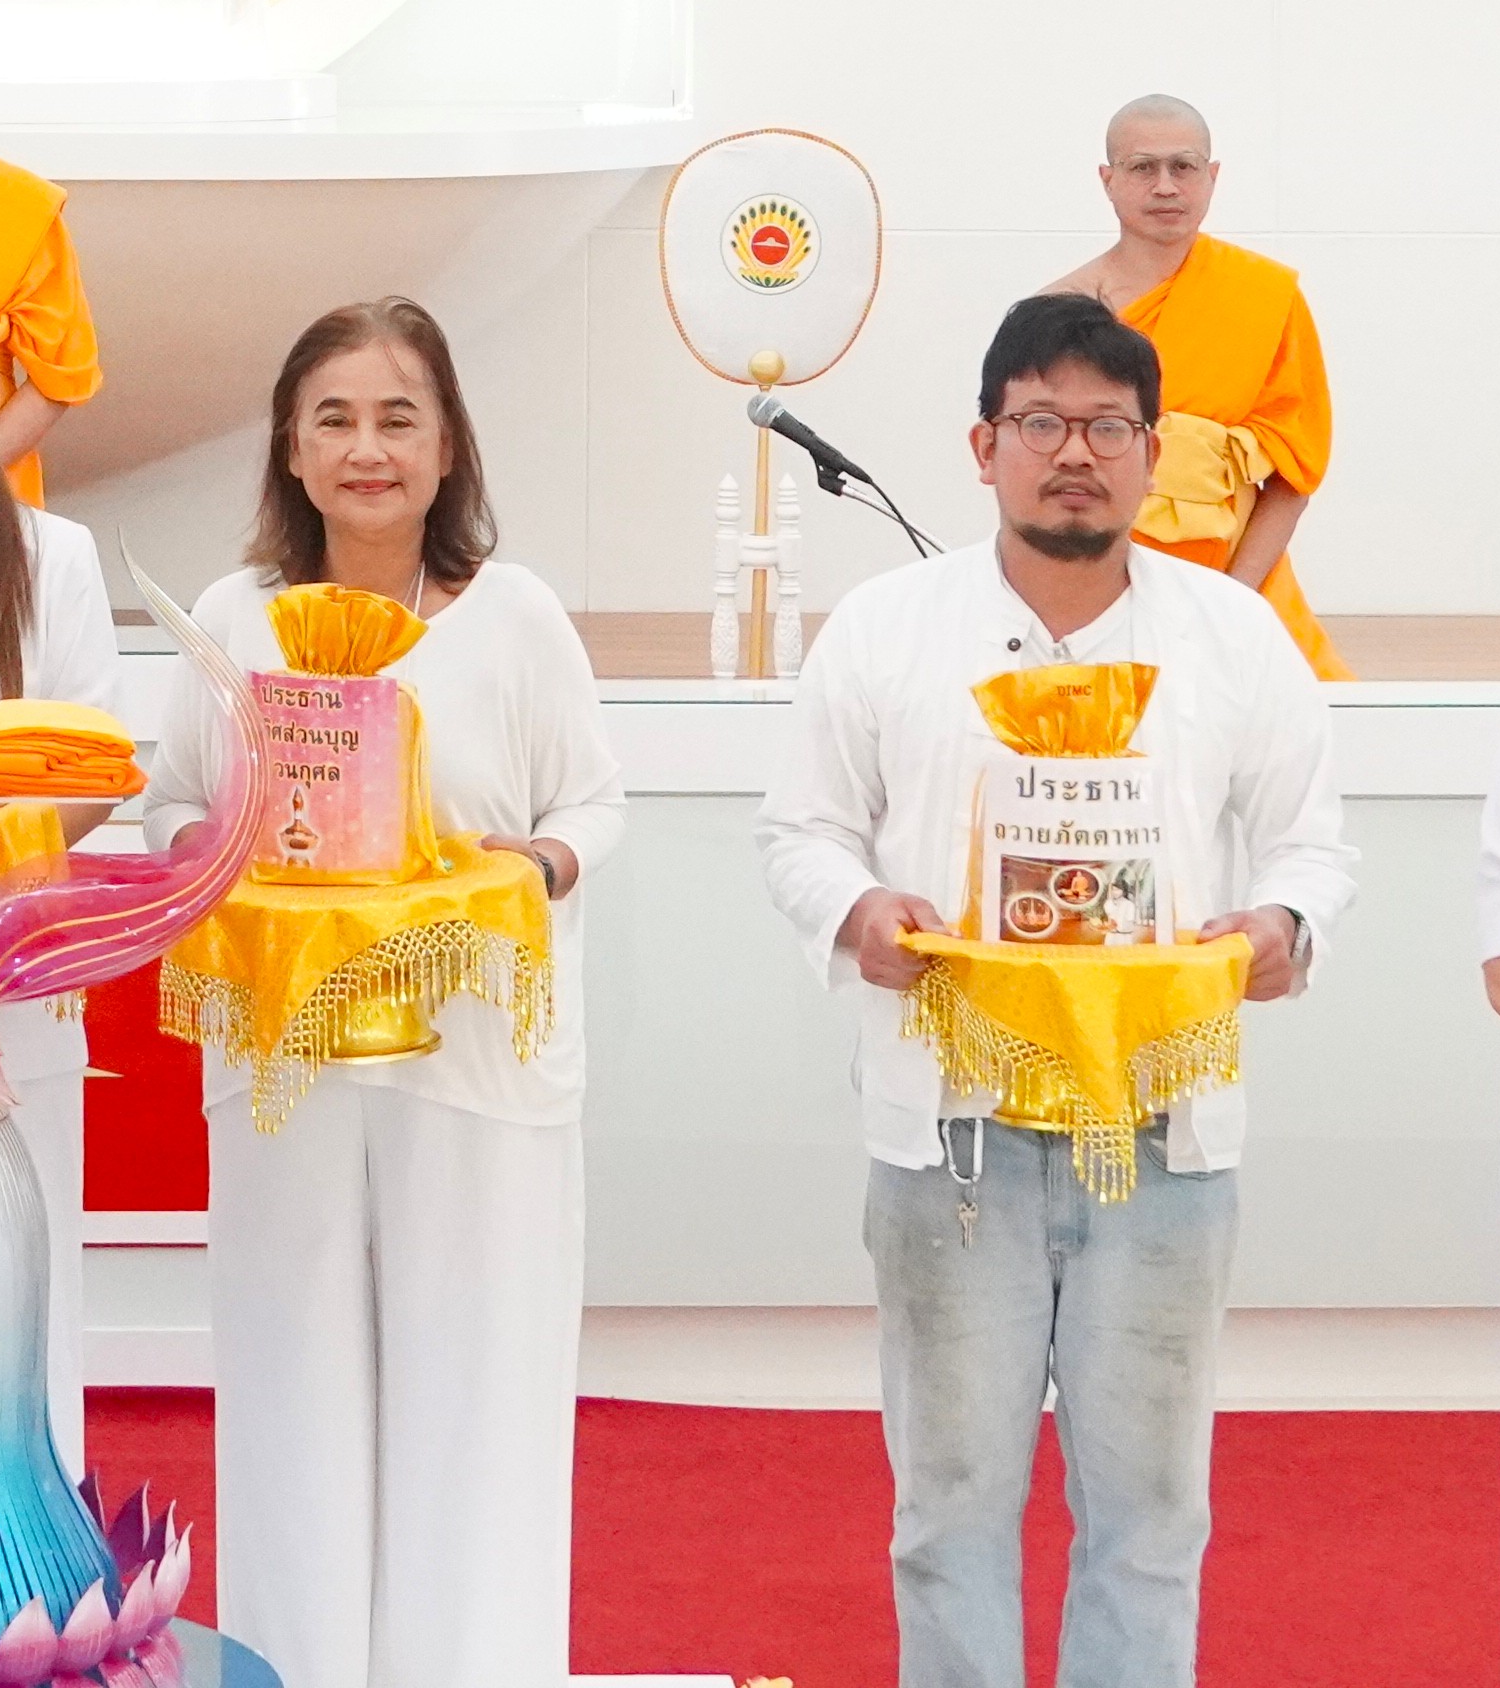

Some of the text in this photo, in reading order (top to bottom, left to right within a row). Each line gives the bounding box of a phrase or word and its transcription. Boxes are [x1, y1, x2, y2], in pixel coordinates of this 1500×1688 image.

[261, 683, 342, 709] ประธาน
[1015, 765, 1141, 801] ประธาน
[994, 820, 1161, 846] ถวายภัตตาหาร
